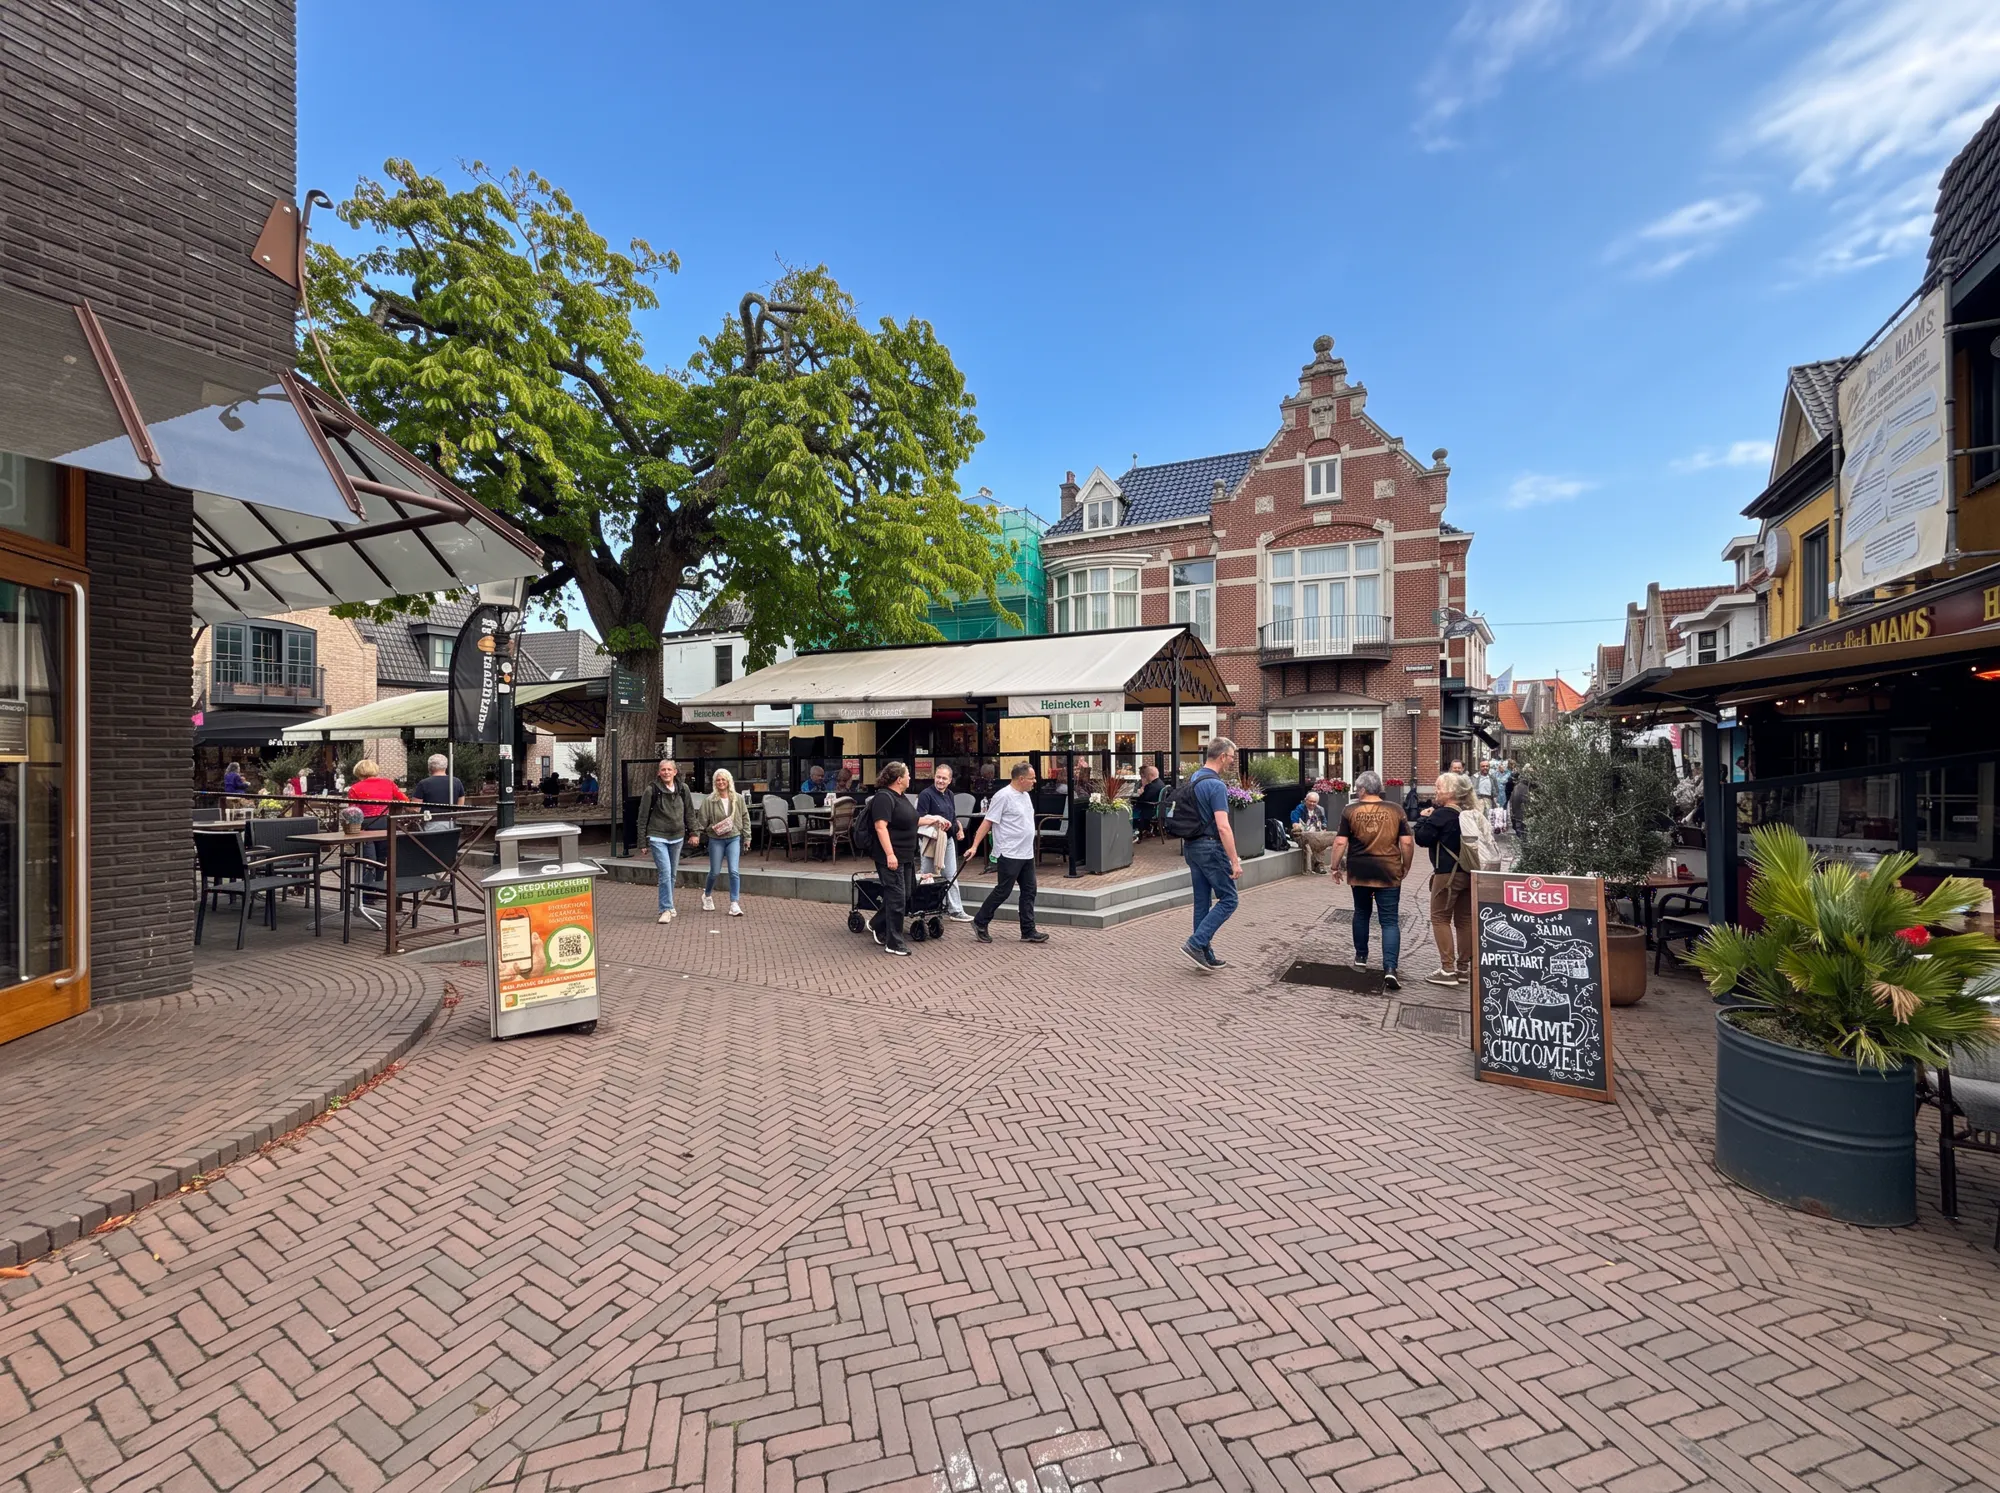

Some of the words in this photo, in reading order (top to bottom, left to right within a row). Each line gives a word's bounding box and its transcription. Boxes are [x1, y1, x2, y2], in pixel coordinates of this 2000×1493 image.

[1895, 308, 1935, 362] MAMS
[1870, 607, 1930, 646] MAMS
[1041, 698, 1090, 710] Heineken
[1507, 886, 1564, 905] TEXELS
[1502, 1014, 1576, 1047] WARME
